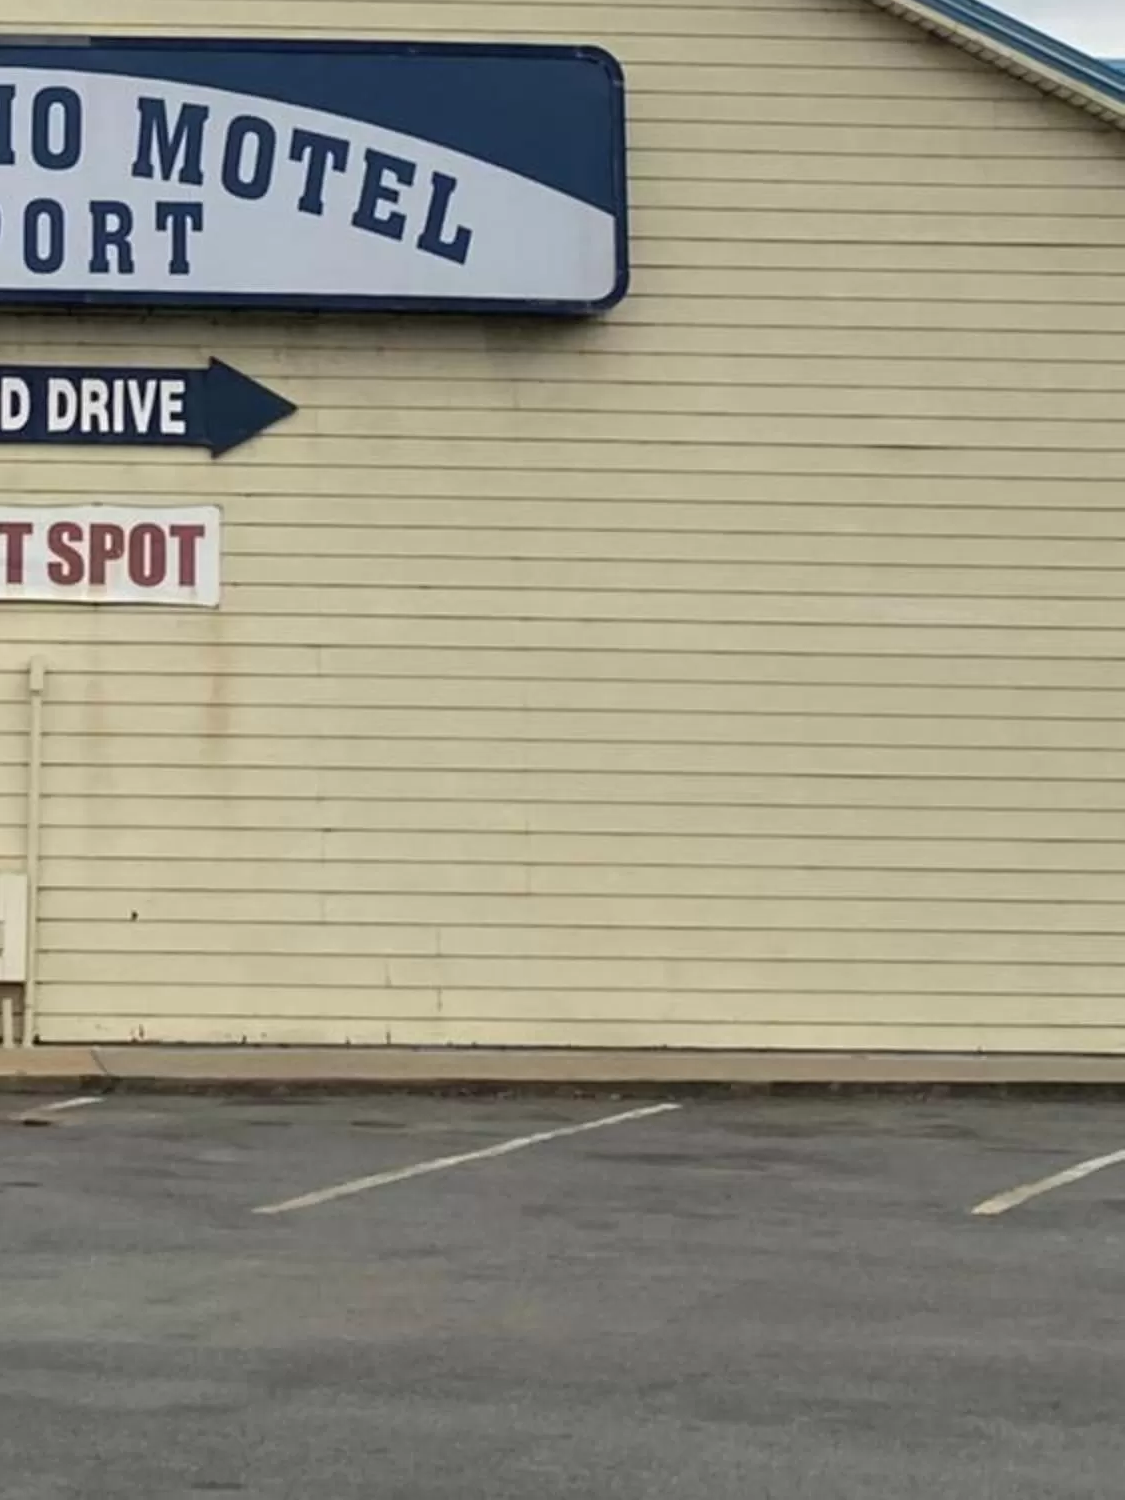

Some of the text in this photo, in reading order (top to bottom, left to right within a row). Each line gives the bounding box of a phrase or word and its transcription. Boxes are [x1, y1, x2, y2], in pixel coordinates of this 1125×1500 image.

[131, 96, 473, 265] MOTEL
[47, 378, 186, 434] DRIVE
[47, 522, 205, 587] SPOT
